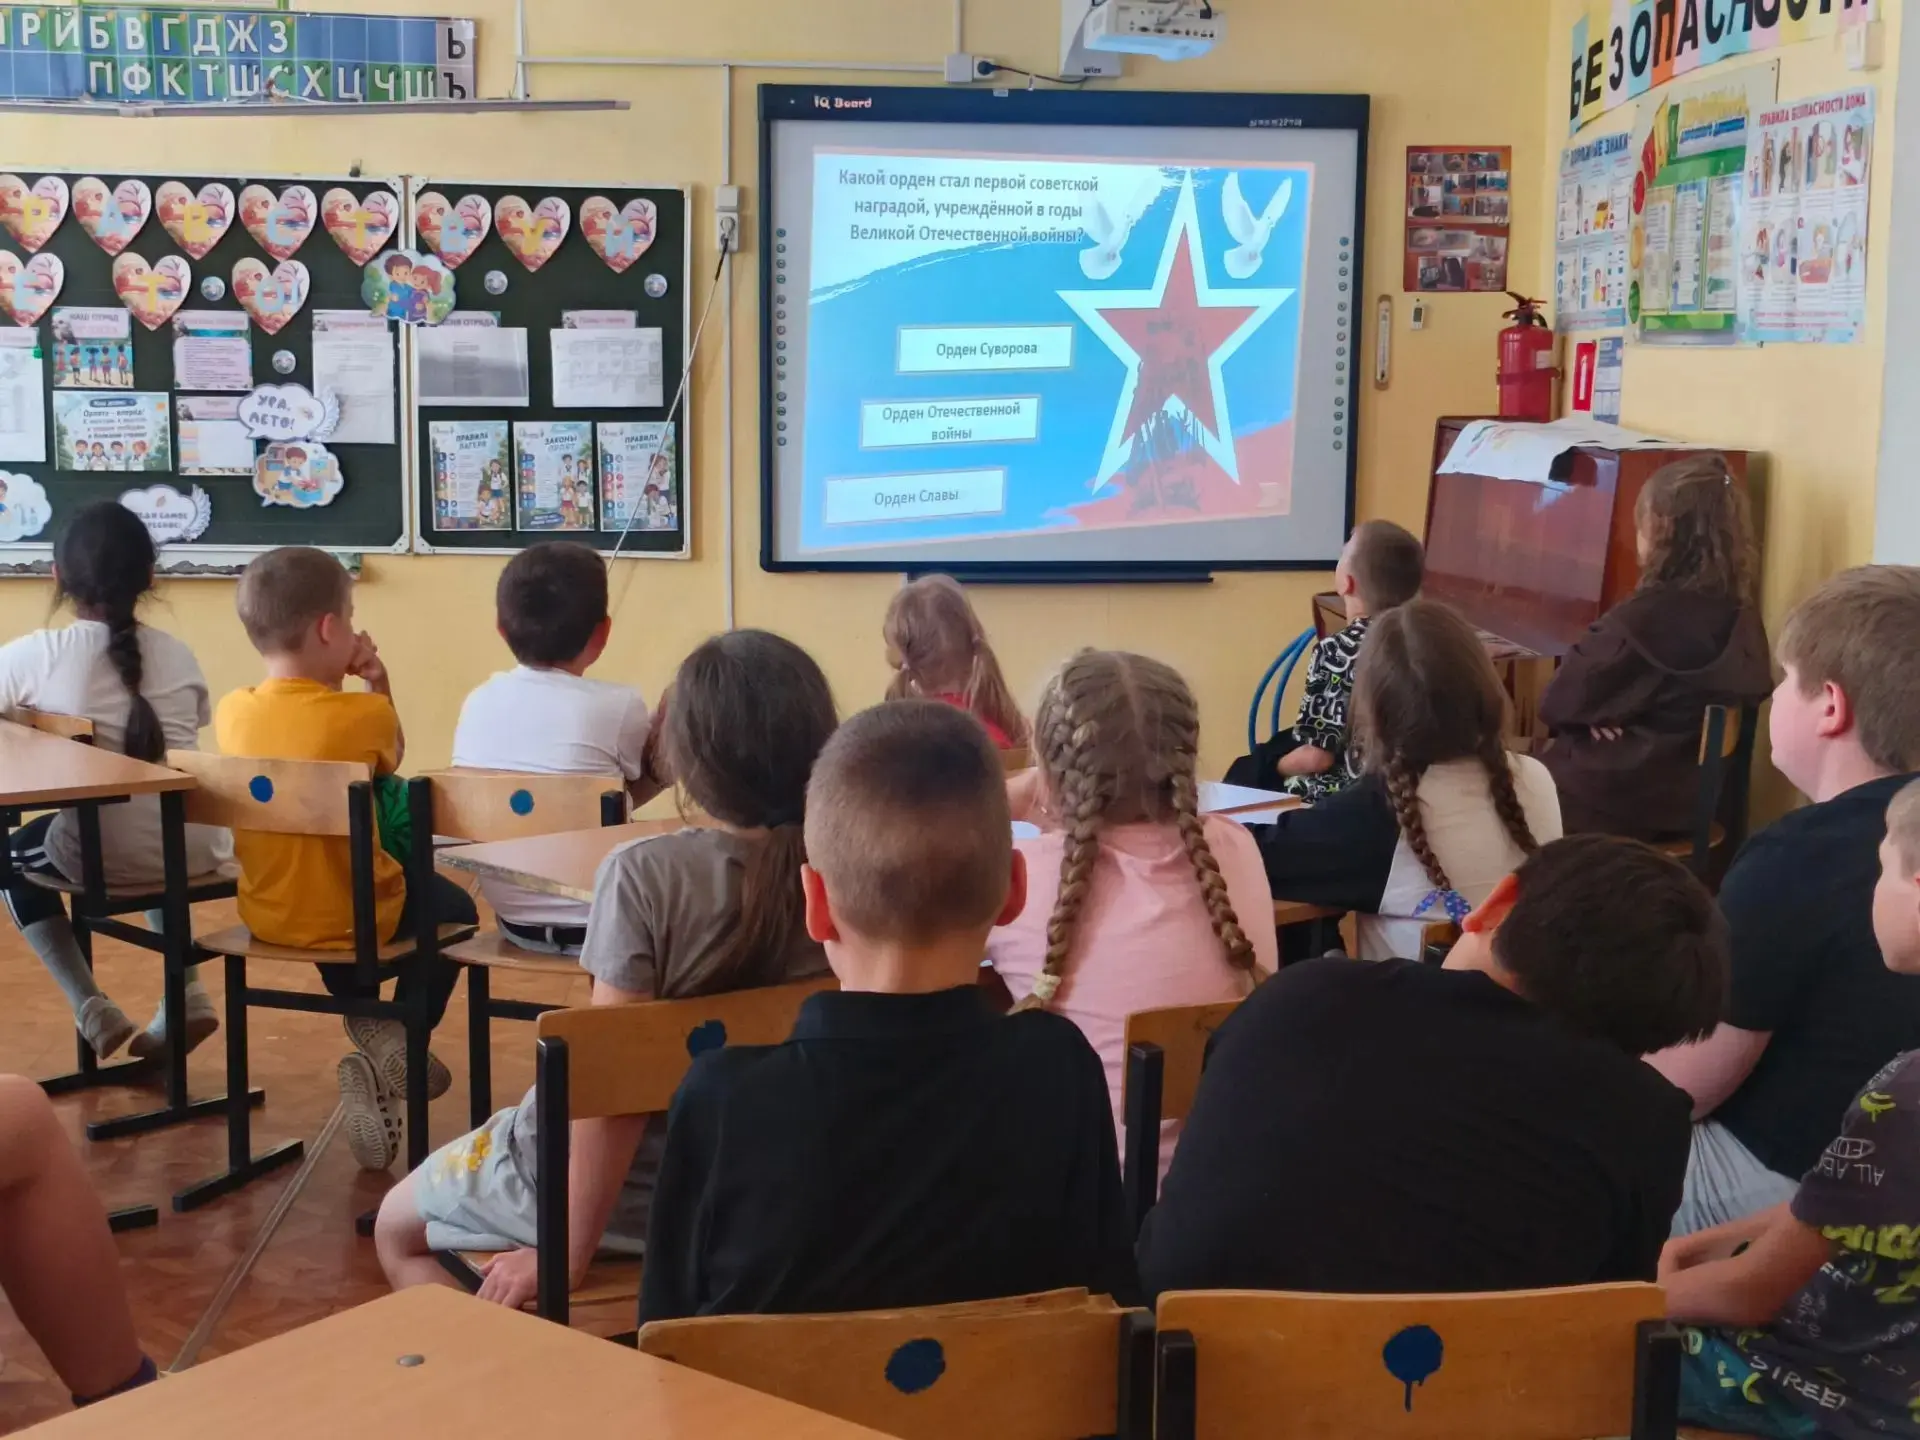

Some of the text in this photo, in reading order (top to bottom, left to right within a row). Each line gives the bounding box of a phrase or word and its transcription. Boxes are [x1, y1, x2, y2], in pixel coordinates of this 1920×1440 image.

[22, 13, 41, 46] Р
[89, 16, 110, 49] Б
[125, 17, 146, 50] В
[162, 18, 181, 51] Г
[193, 18, 221, 57] Д
[226, 19, 259, 53] Ж
[1570, 0, 1866, 120] БЕЗОПАСН
[122, 63, 152, 96] Ф
[162, 64, 187, 97] К
[199, 65, 221, 97] Т
[838, 168, 1099, 193] Какой орден стал первой советской
[854, 197, 1083, 220] наградой, учреждённой в годы
[850, 224, 1084, 244] Великой Отечественной войны?
[936, 342, 1038, 360] Орден Суворова
[249, 412, 296, 431] ЛЕТО!
[882, 401, 1021, 423] Орден Отечественной
[456, 431, 489, 442] ПРАВИЛА
[544, 435, 578, 446] ЗАКОНЫ
[625, 434, 659, 444] ПРАВИЛА
[931, 425, 972, 442] войны
[874, 487, 959, 508] Орден Славы
[1853, 1162, 1886, 1186] ALL
